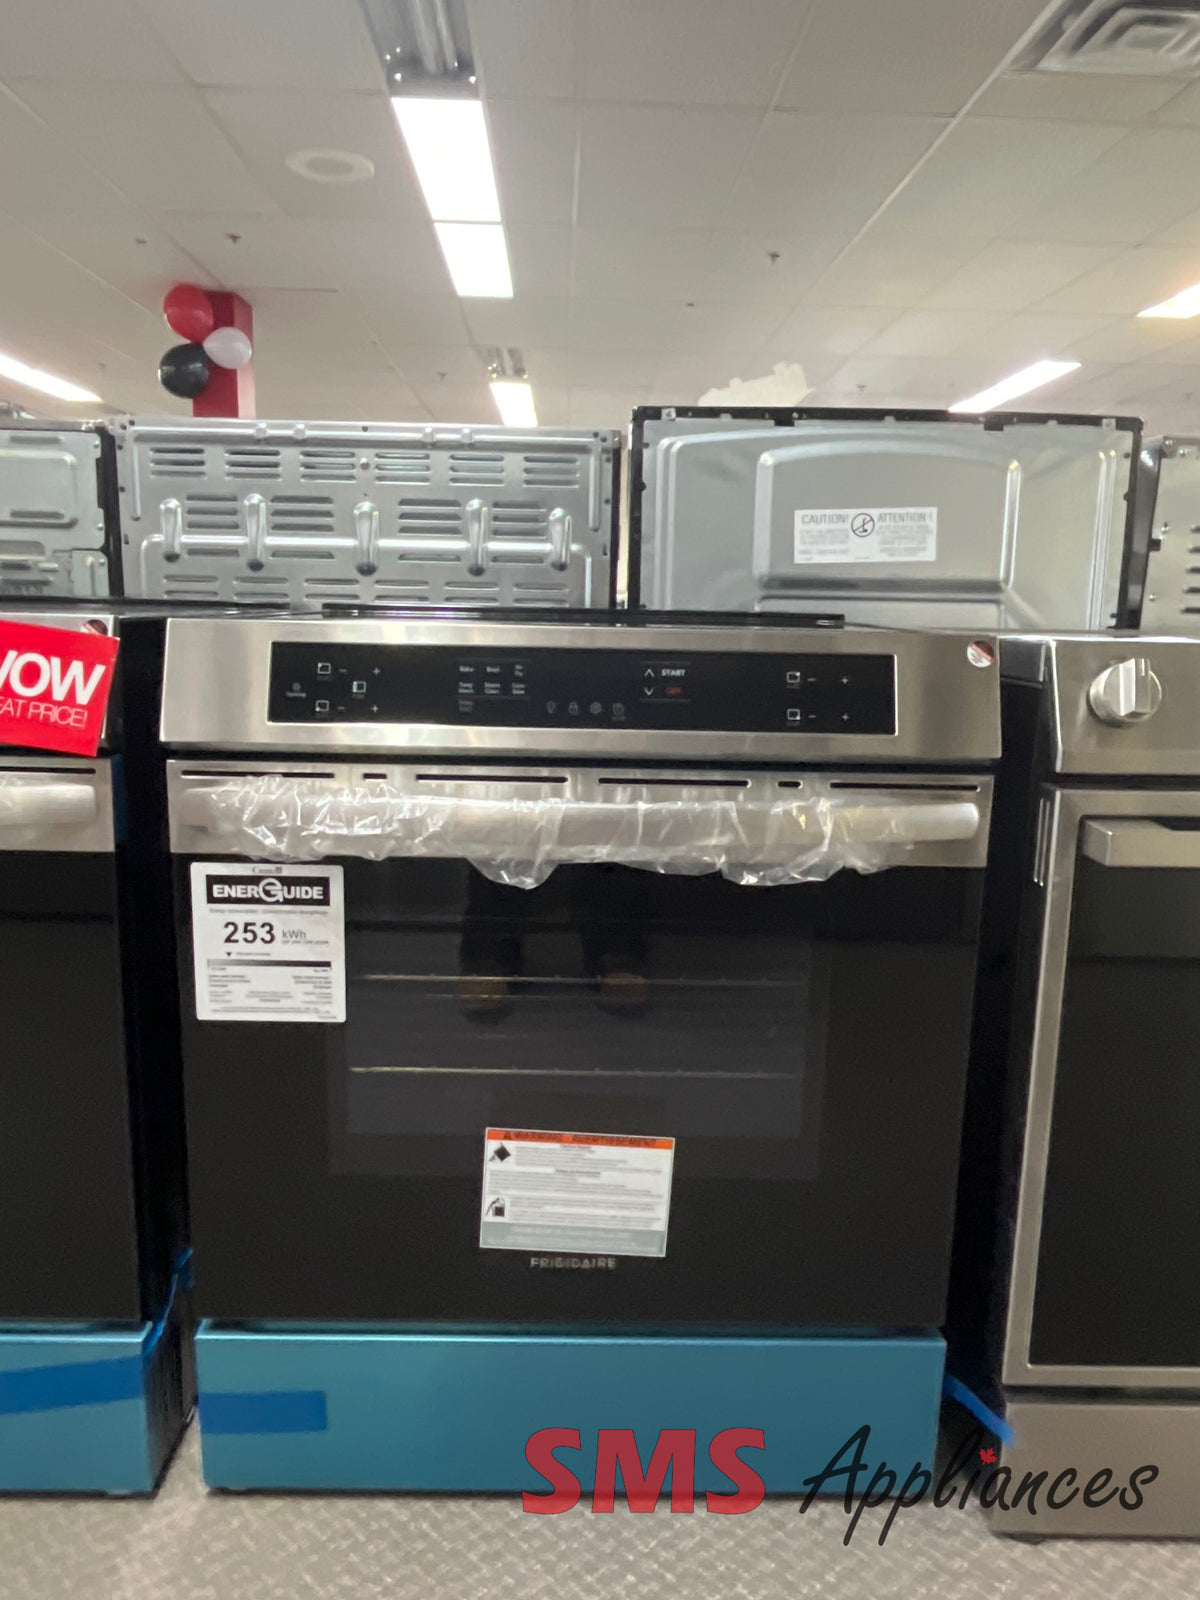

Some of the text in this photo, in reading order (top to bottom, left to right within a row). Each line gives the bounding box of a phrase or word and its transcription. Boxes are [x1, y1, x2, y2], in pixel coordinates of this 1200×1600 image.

[661, 668, 686, 677] START
[28, 701, 88, 729] PRICE!
[212, 877, 324, 902] ENERGUIDE
[223, 921, 307, 944] 253 kWh
[529, 1257, 617, 1270] FRIGIDAIRE
